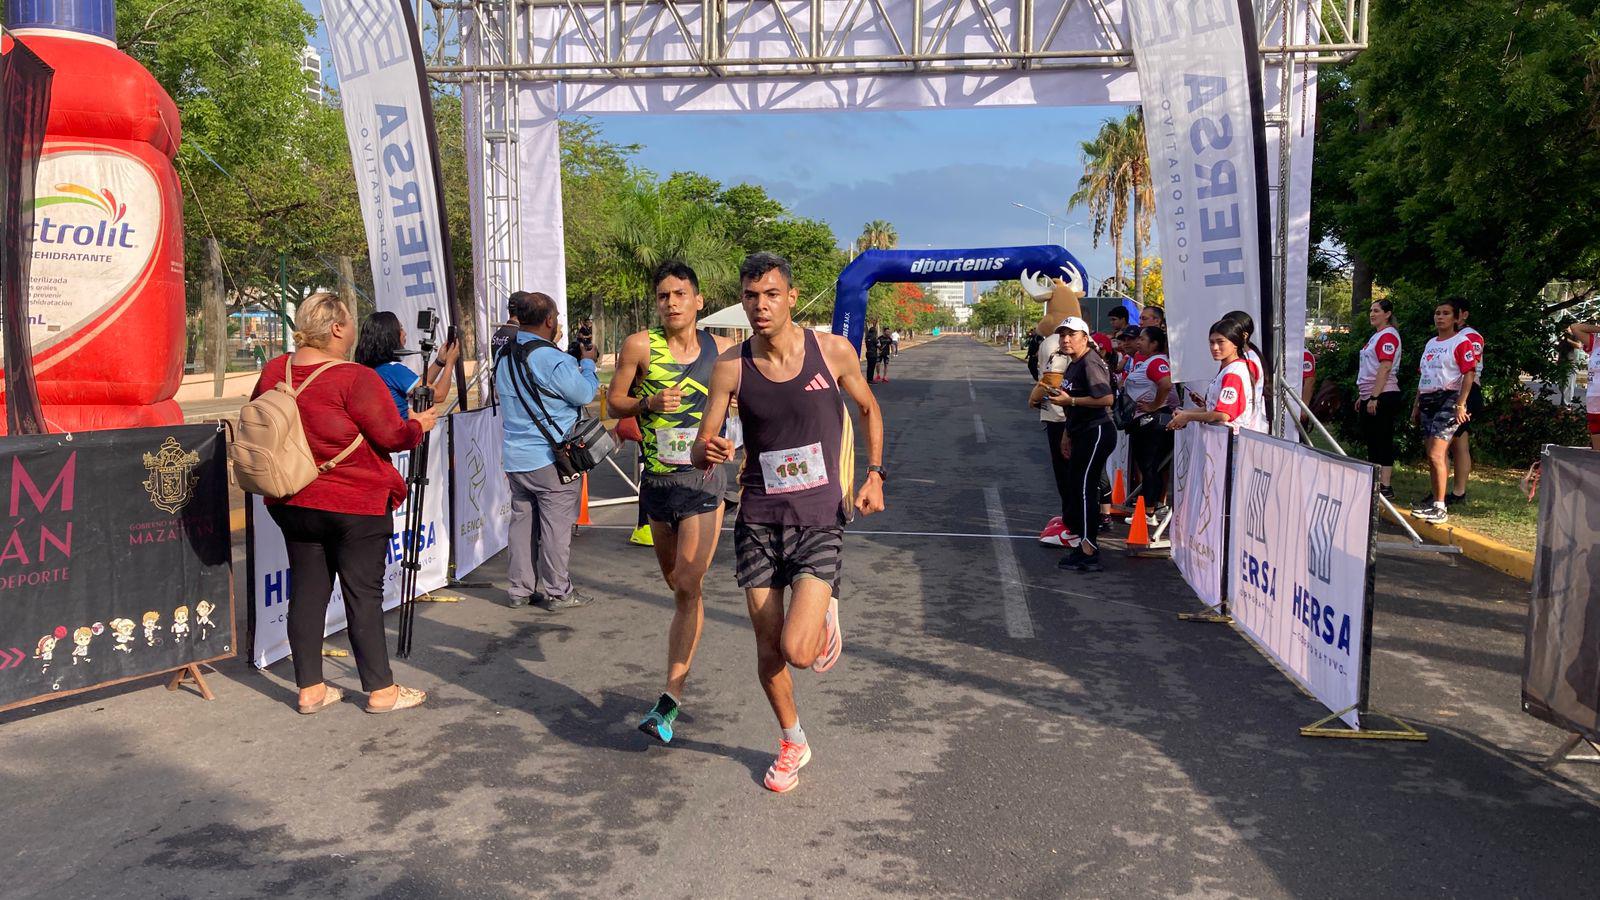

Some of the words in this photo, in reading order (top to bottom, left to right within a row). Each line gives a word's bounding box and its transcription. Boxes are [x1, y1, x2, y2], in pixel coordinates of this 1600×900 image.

[910, 257, 1004, 275] dportenis
[1222, 389, 1235, 400] 115
[1292, 581, 1350, 657] HERSA
